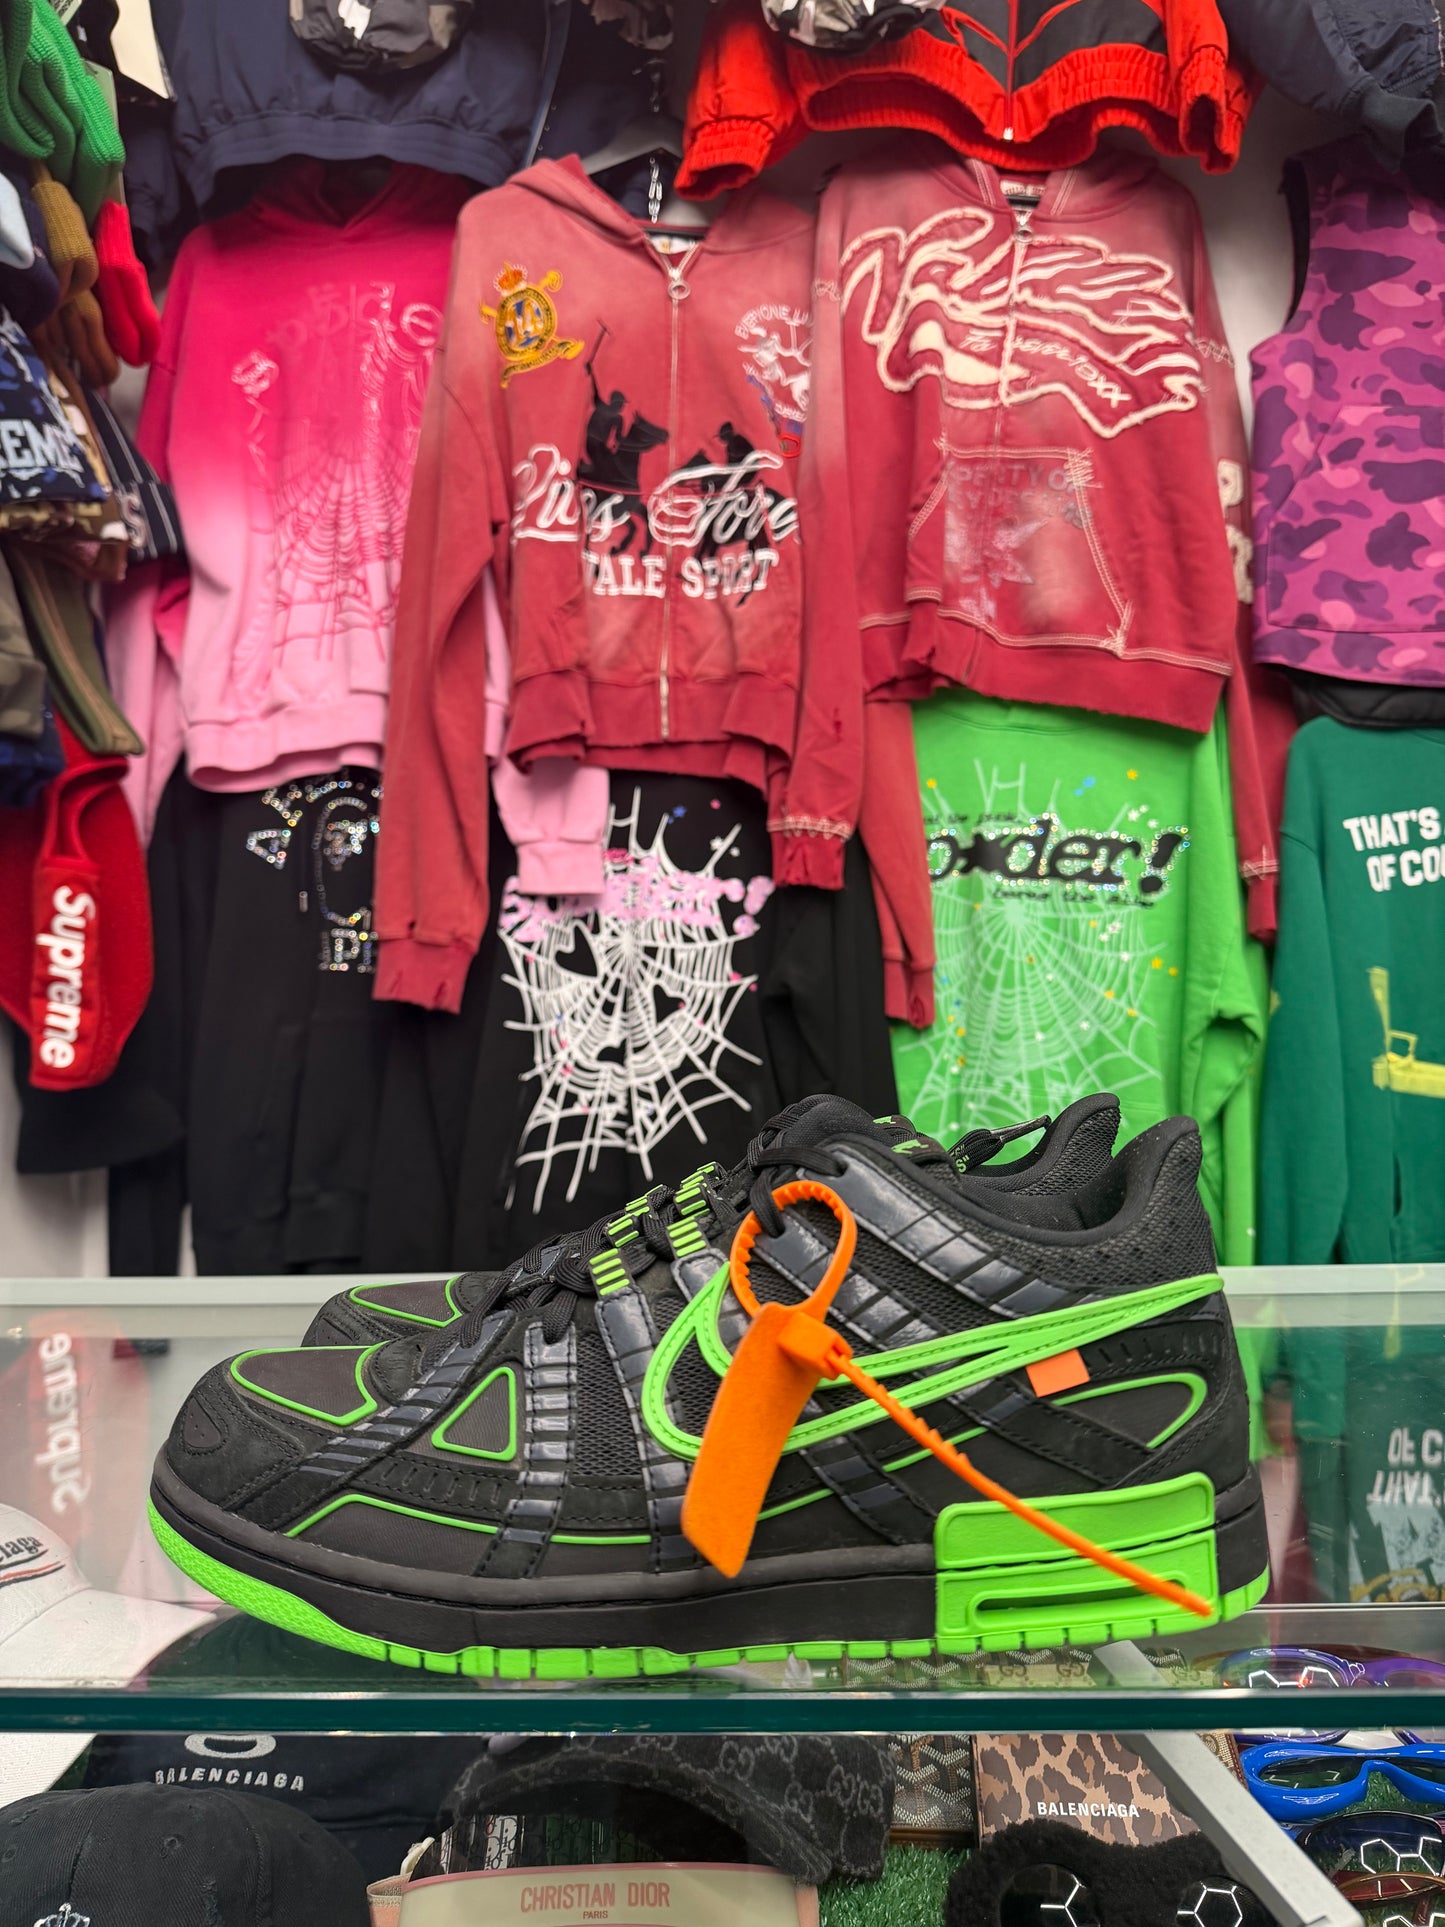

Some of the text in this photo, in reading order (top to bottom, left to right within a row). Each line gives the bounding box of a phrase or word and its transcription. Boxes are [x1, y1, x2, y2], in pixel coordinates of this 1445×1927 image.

[0, 419, 85, 473] EME
[1342, 806, 1442, 852] THAT'S
[1366, 853, 1397, 893] OF
[35, 885, 97, 1069] Supreme
[0, 1536, 43, 1560] iaga
[155, 1767, 304, 1791] BALENCIAGA
[1037, 1801, 1140, 1818] BALENCIAGA
[520, 1882, 670, 1913] CHRISTIAN DIOR
[582, 1910, 609, 1920] PARIS
